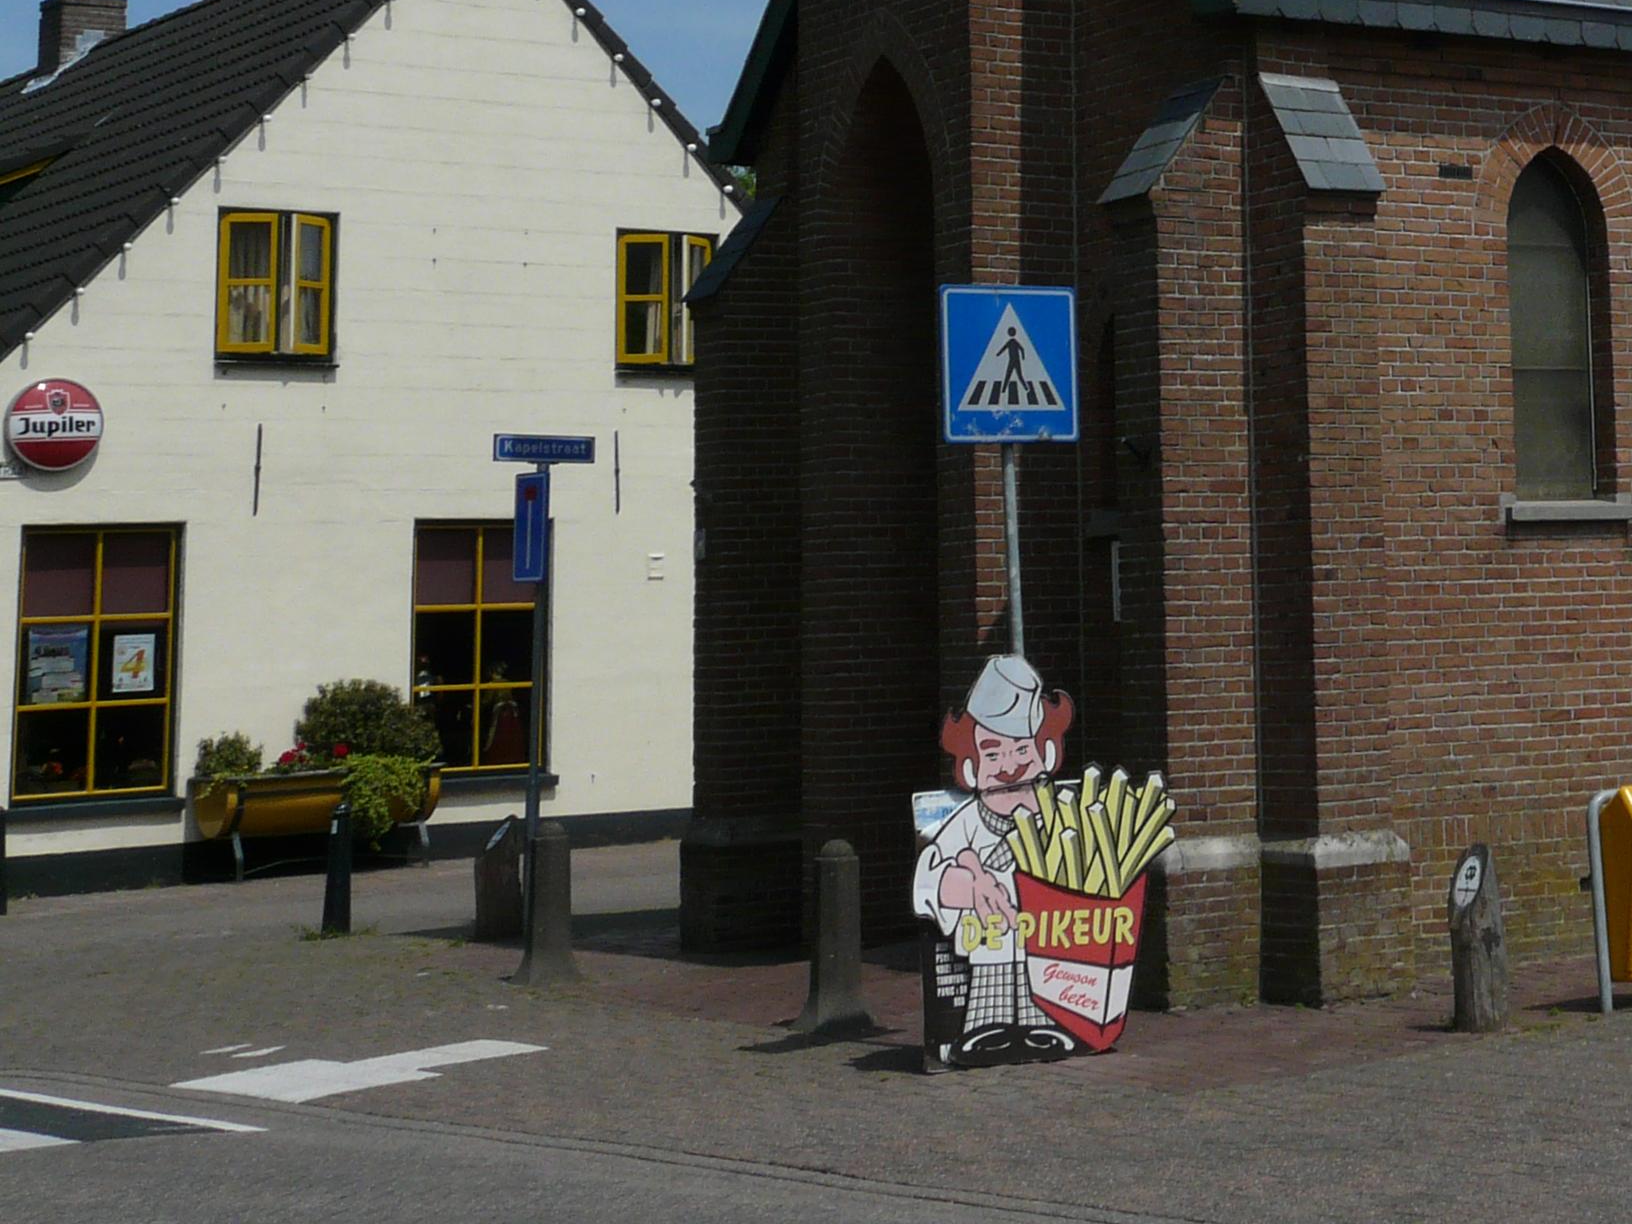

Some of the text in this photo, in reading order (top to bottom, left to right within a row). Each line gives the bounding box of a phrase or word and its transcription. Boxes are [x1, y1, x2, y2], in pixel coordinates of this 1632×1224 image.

[17, 416, 95, 438] Jupiler
[503, 439, 586, 455] Kapelstraat
[961, 906, 1136, 952] DE PIKEUR
[1058, 985, 1100, 1011] beter
